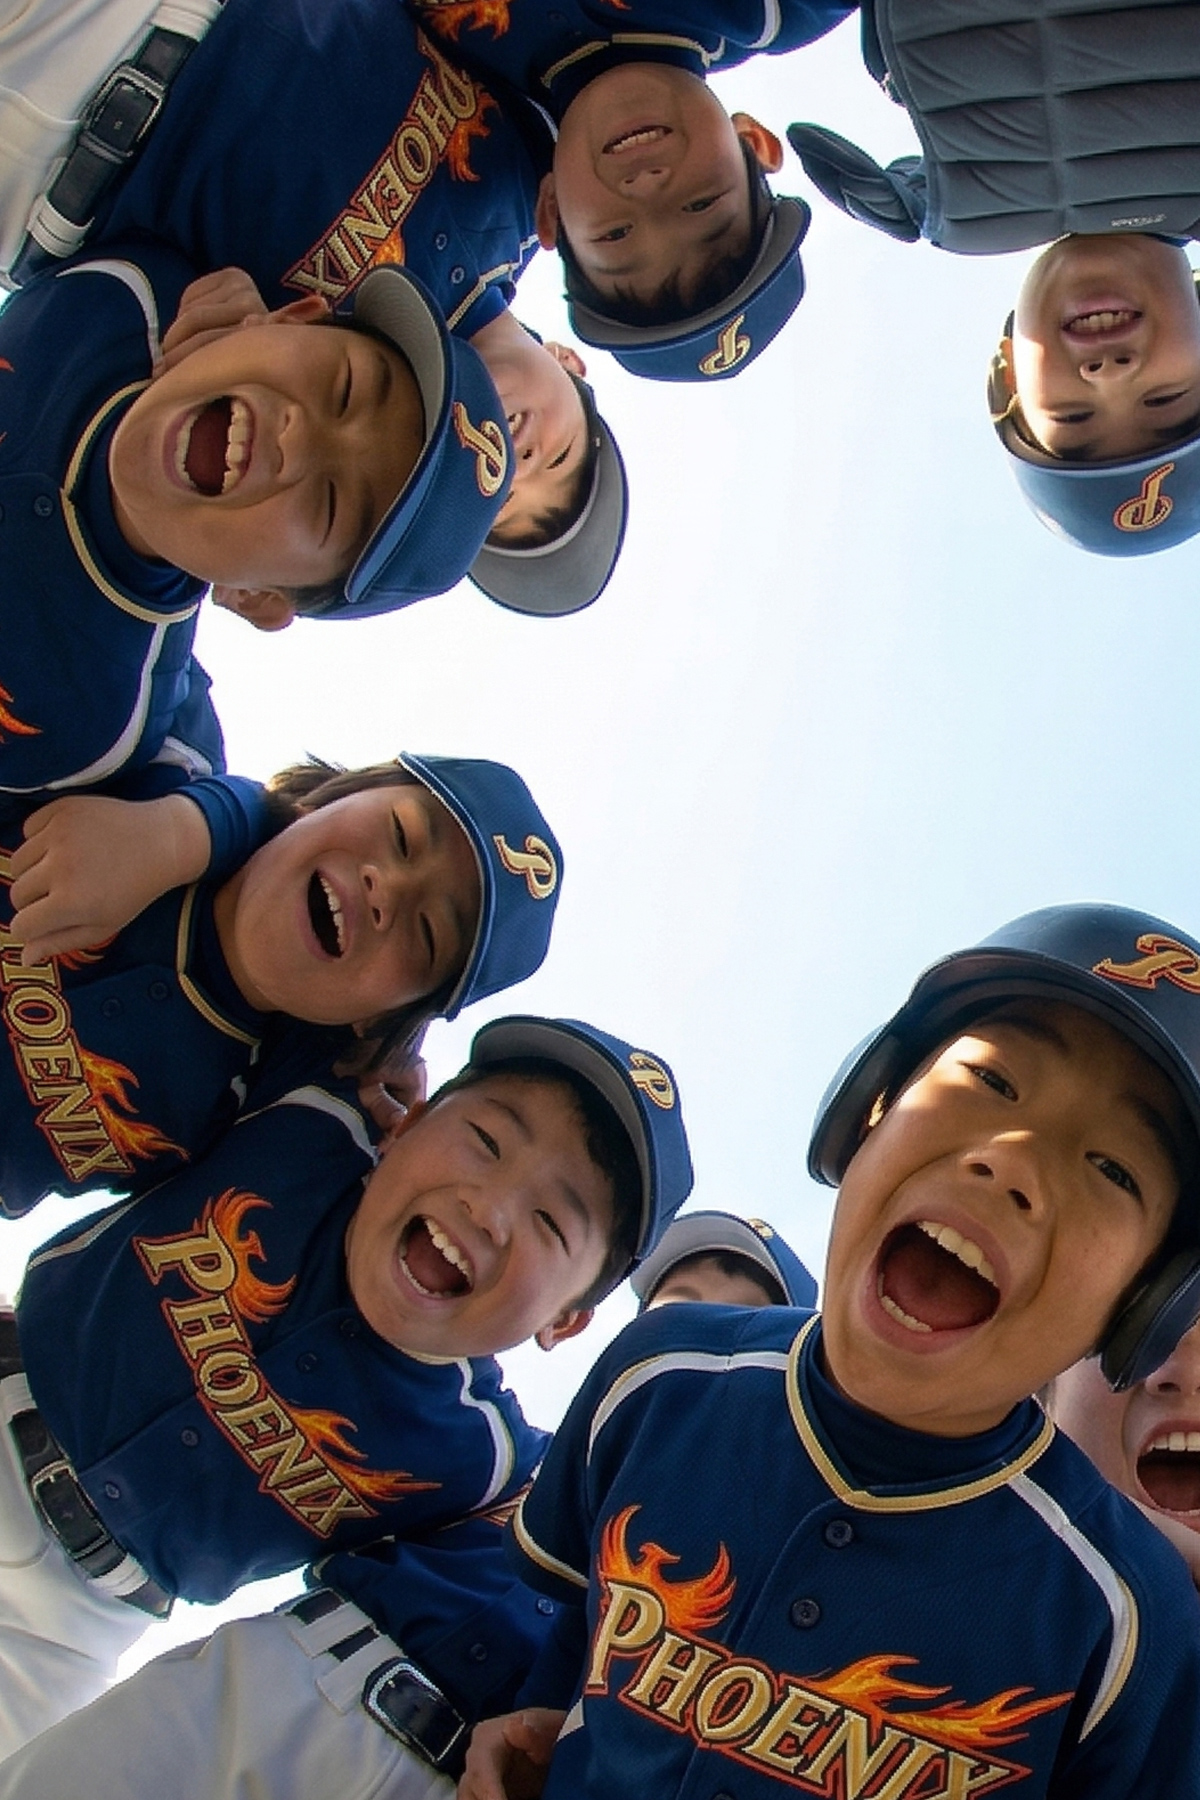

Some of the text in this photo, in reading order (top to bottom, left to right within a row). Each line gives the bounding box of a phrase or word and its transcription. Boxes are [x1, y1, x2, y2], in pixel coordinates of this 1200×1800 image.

[282, 28, 476, 304] PHOENIX
[698, 312, 751, 376] P
[452, 401, 507, 497] P
[1113, 462, 1175, 532] P
[492, 834, 557, 900] P
[0, 850, 136, 1184] HOENIX
[629, 1052, 675, 1109] P
[134, 1210, 378, 1537] PHOENIX
